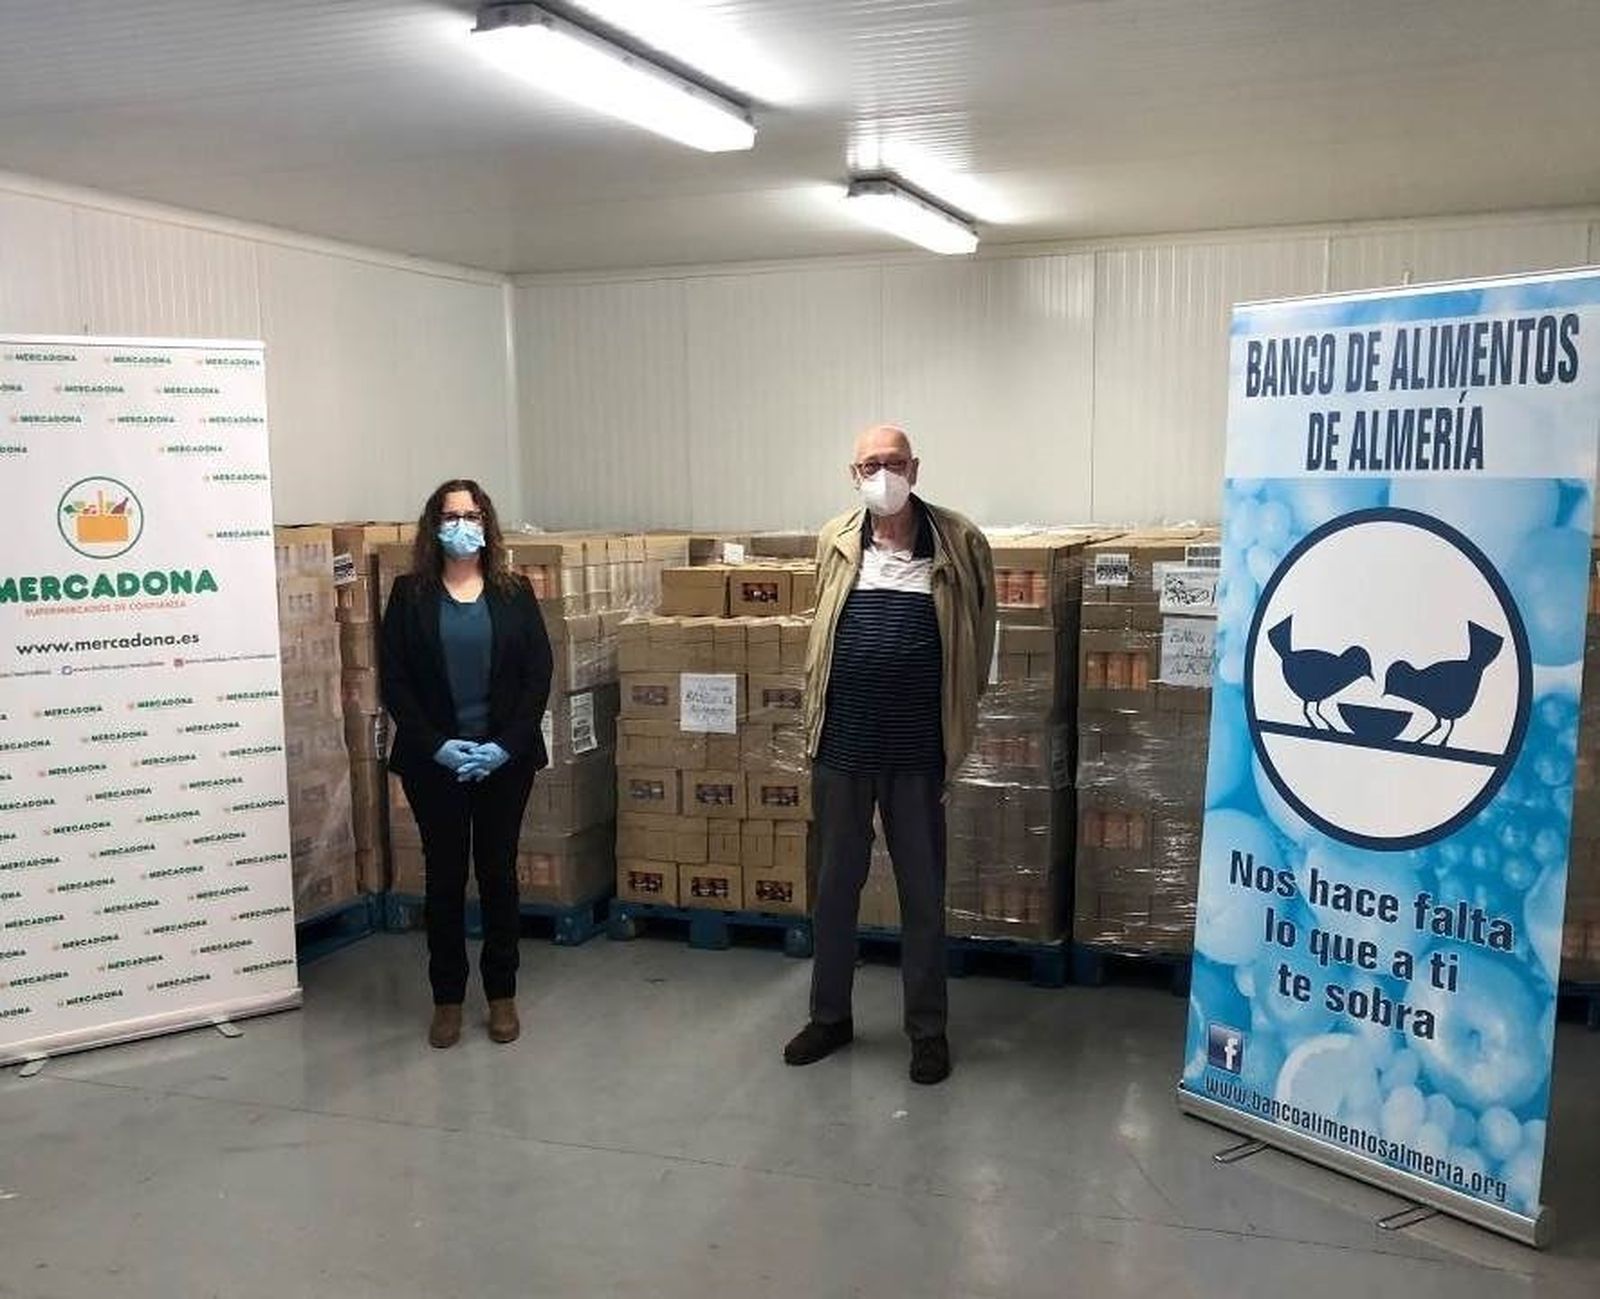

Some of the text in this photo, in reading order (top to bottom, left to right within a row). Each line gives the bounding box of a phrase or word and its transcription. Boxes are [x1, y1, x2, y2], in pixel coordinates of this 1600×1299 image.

[15, 353, 77, 361] MERCADONA
[113, 356, 171, 364] MERCADONA
[1246, 313, 1580, 397] BANCO DE ALIMENTOS
[205, 358, 260, 367] MERCADONA
[20, 415, 81, 423] MERCADONA
[1305, 390, 1484, 471] DE ALMERÍA
[167, 445, 222, 453] MERCADONA
[216, 530, 270, 538] MERCADONA
[0, 570, 218, 603] MERCADONA
[16, 633, 200, 655] www.mercadona.es
[226, 690, 279, 700] MERCADONA
[137, 698, 193, 708] MERCADONA
[44, 706, 102, 716] MERCADONA
[185, 722, 240, 732] MERCADONA
[91, 731, 148, 742] MERCADONA
[229, 746, 282, 756] MERCADONA
[141, 754, 196, 765] MERCADONA
[48, 765, 107, 776] MERCADONA
[189, 777, 243, 789] MERCADONA
[95, 787, 152, 800] MERCADONA
[232, 800, 285, 811] MERCADONA
[145, 810, 200, 822] MERCADONA
[53, 822, 110, 834] MERCADONA
[193, 832, 246, 844] MERCADONA
[99, 844, 155, 857] MERCADONA
[0, 857, 60, 870] MERCADONA
[236, 853, 287, 866] MERCADONA
[149, 866, 203, 878] MERCADONA
[57, 878, 115, 892] MERCADONA
[196, 886, 249, 899] MERCADONA
[103, 900, 159, 913] MERCADONA
[1230, 850, 1513, 951] Nos hace falta
[239, 906, 291, 920] MERCADONA
[5, 915, 64, 929] MERCADONA
[153, 920, 207, 933] MERCADONA
[62, 934, 119, 949] MERCADONA
[200, 940, 253, 953] MERCADONA
[1264, 908, 1458, 992] lo que a ti
[108, 955, 163, 969] MERCADONA
[242, 959, 294, 973] MERCADONA
[10, 972, 69, 987] MERCADONA
[157, 974, 210, 988] MERCADONA
[67, 990, 123, 1005] MERCADONA
[1278, 963, 1435, 1040] te sobra
[1205, 1074, 1509, 1202] www.bancoalimentosalmeria.org
